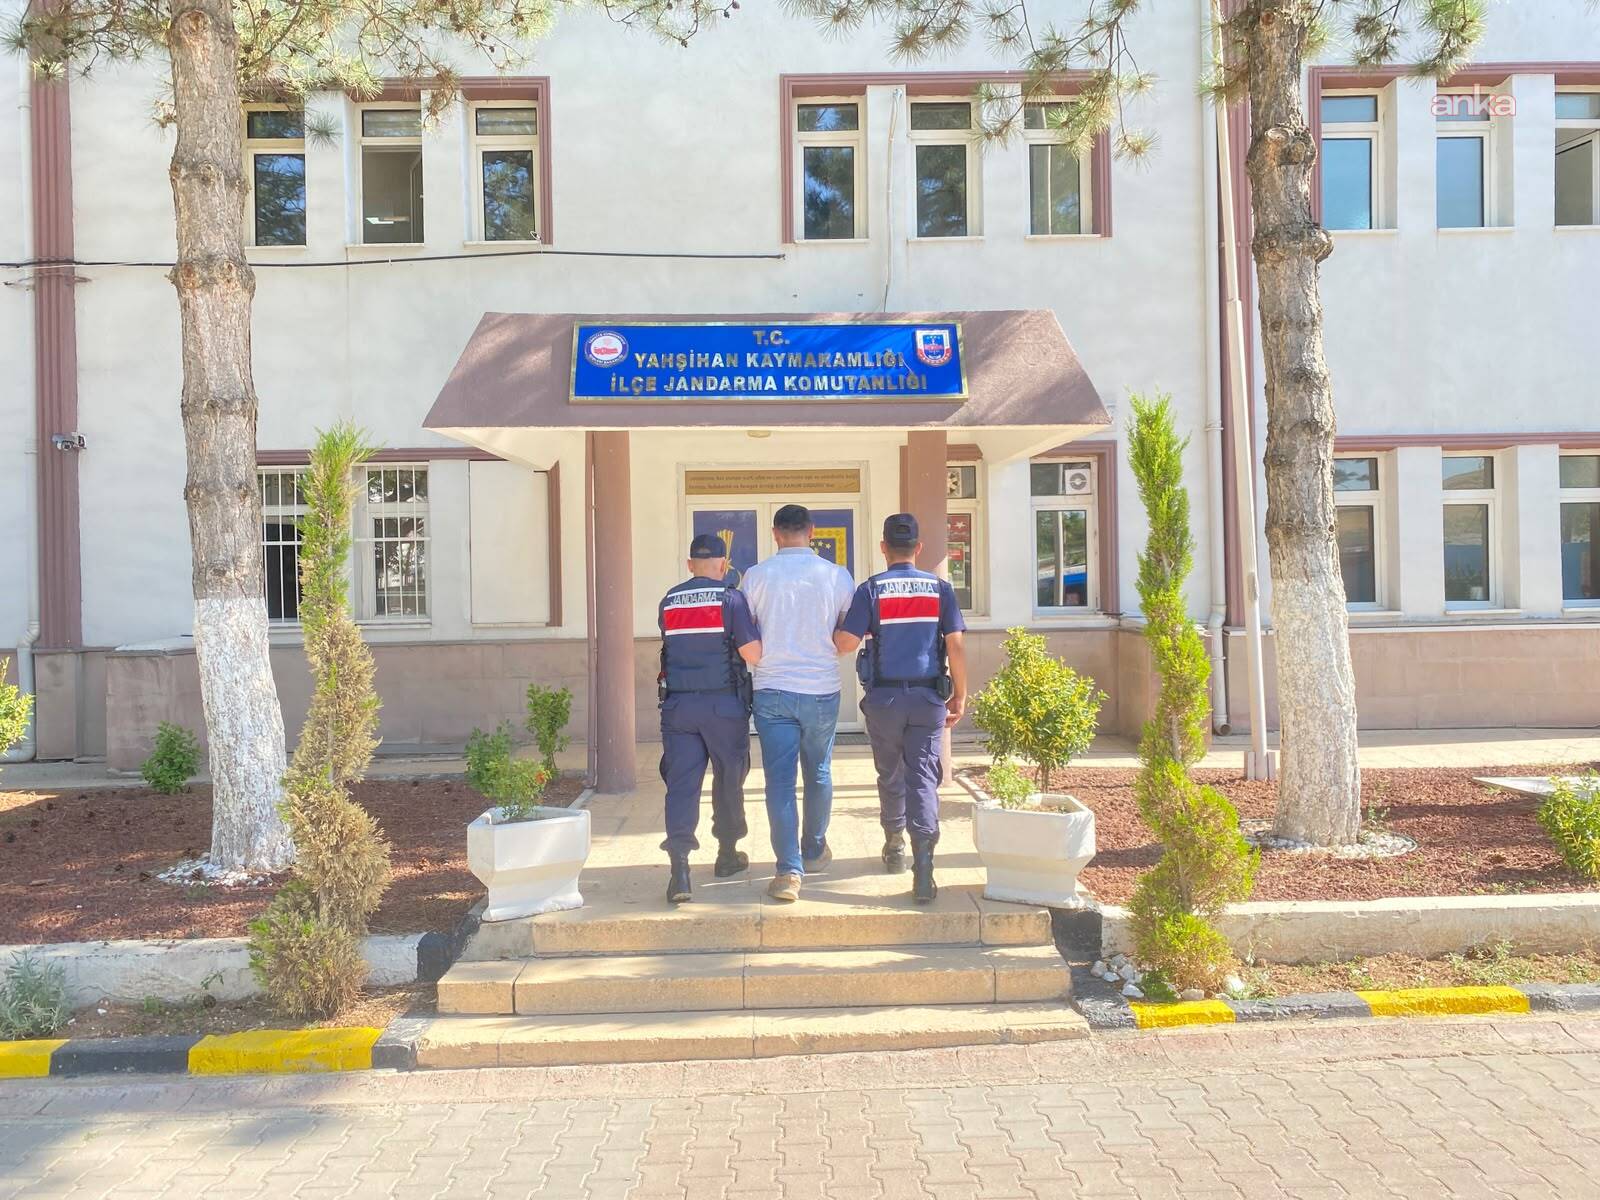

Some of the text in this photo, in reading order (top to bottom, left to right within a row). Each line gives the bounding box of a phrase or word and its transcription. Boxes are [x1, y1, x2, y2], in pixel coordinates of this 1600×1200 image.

[752, 330, 790, 346] T.C.
[634, 350, 739, 373] YAHŞİHAN
[746, 348, 905, 370] KAYMAKAMLIĞI
[610, 372, 928, 396] İLÇE JANDARMA KOMUTANLIĞI
[883, 581, 934, 594] JANDARMA
[670, 590, 718, 605] JANDARMA
